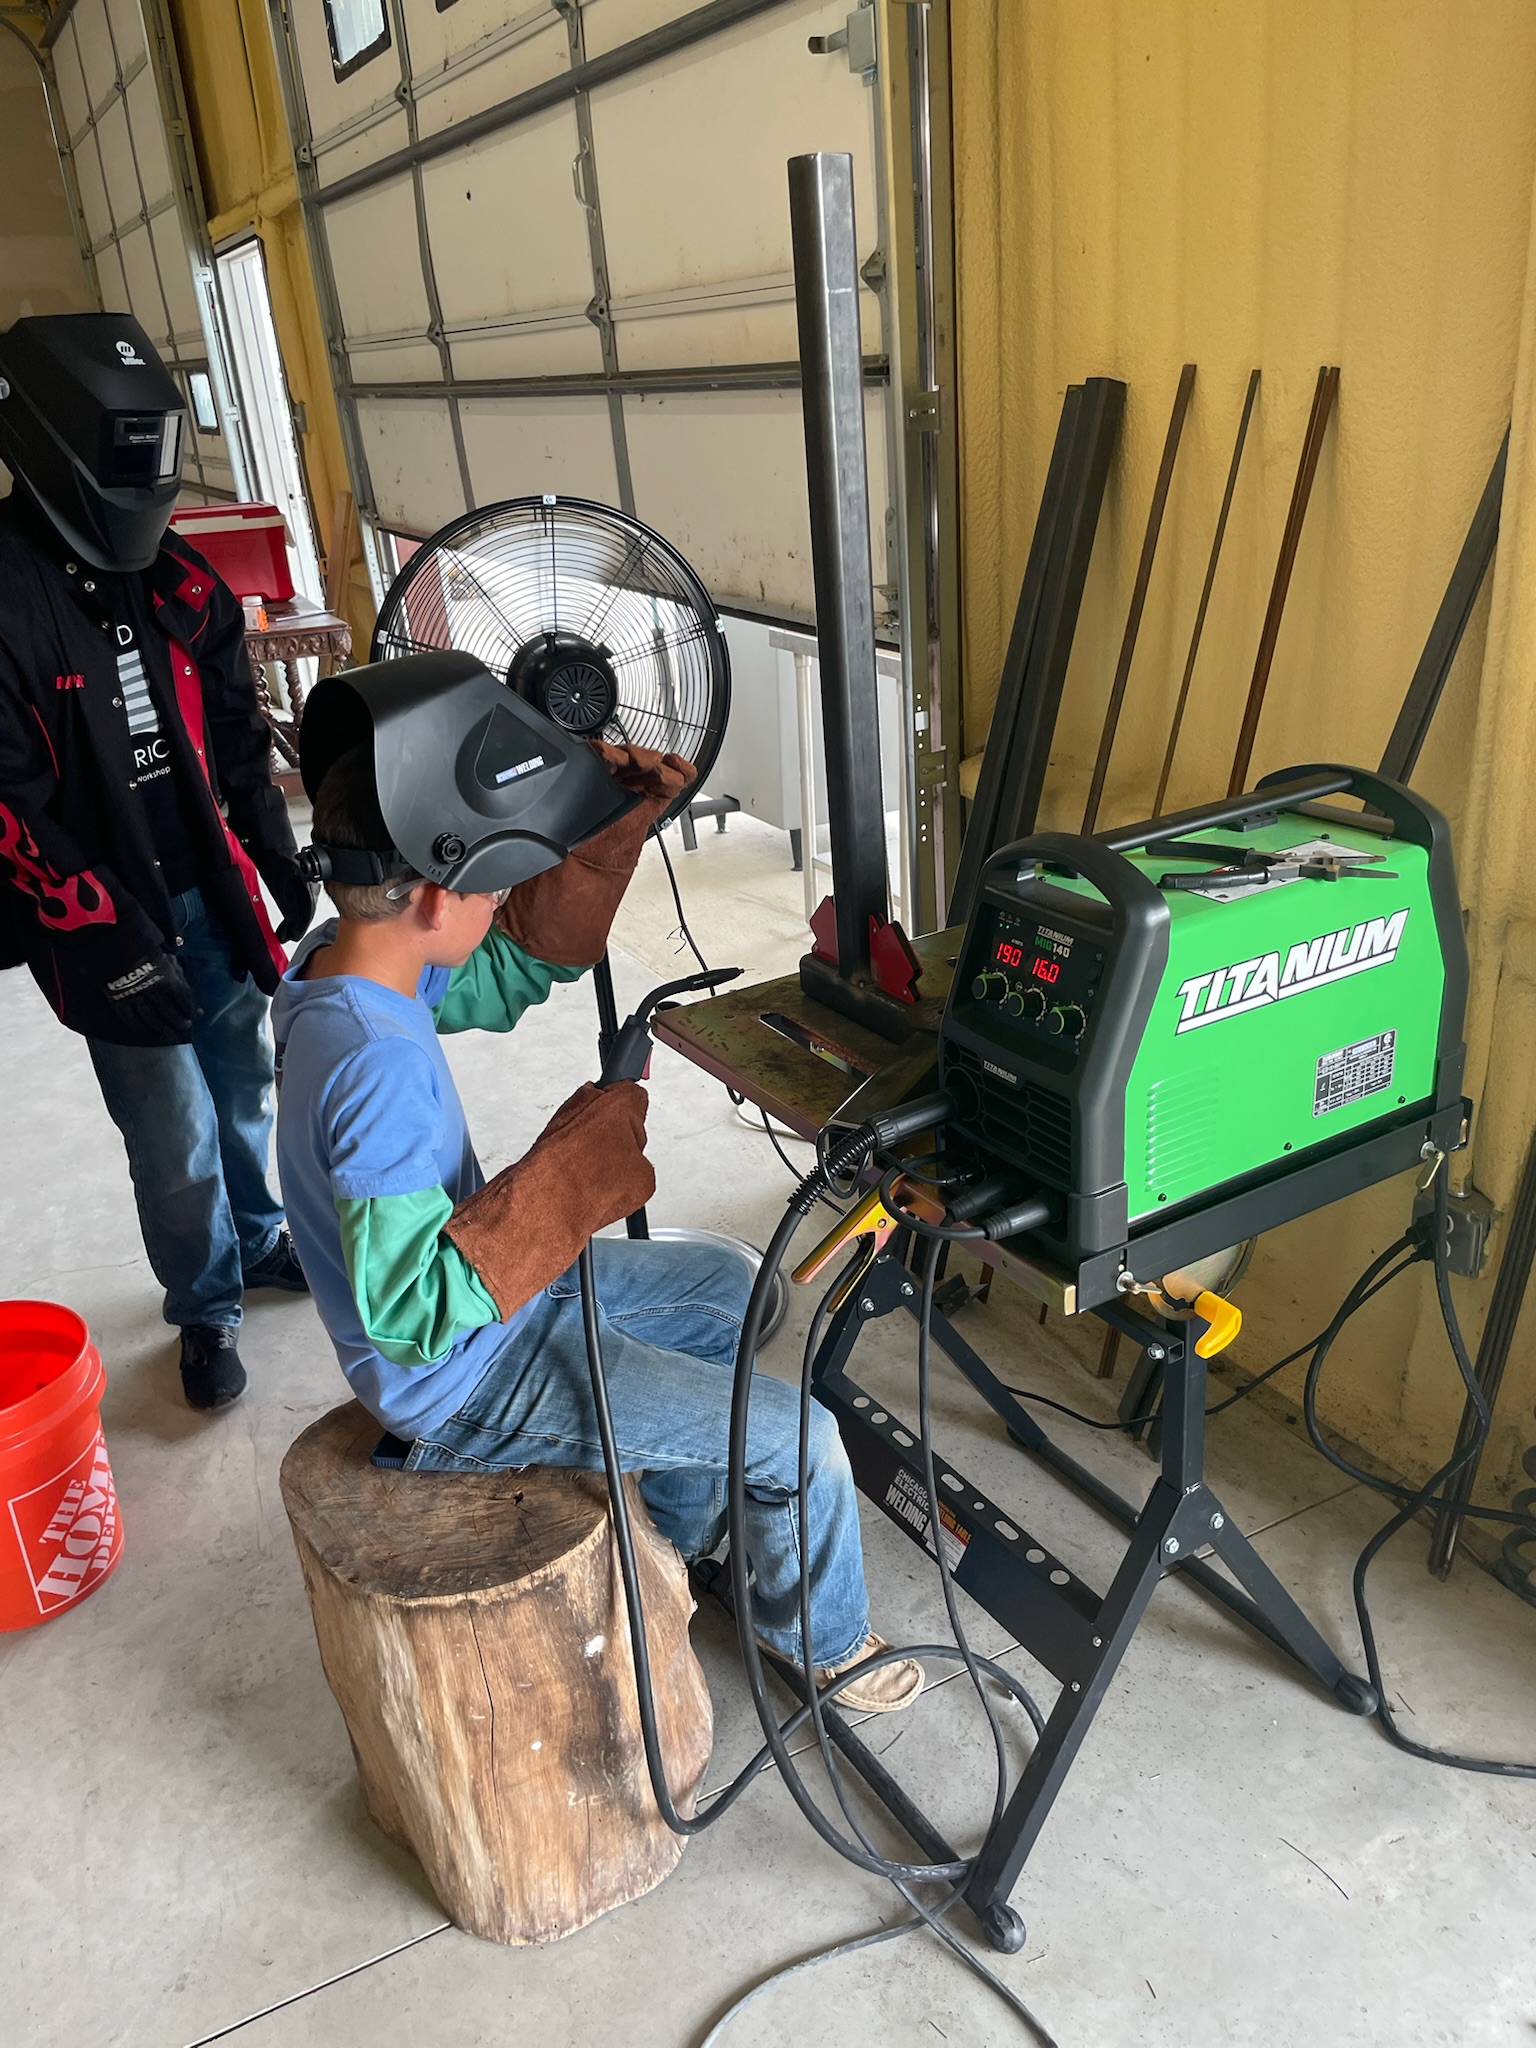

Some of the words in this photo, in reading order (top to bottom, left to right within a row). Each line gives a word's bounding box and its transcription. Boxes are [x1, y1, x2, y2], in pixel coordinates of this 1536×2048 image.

[1035, 936, 1053, 951] MIG
[1053, 942, 1071, 958] 140
[1037, 925, 1075, 948] TITANIUM
[996, 943, 1023, 967] 190
[1175, 907, 1411, 1035] TITANIUM
[983, 1060, 1018, 1084] TITANIUM
[894, 1475, 930, 1511] ELECTRIC
[898, 1468, 929, 1499] CHICAGO
[36, 1428, 110, 1599] HOME
[38, 1479, 87, 1543] THE
[885, 1483, 928, 1533] WELDING
